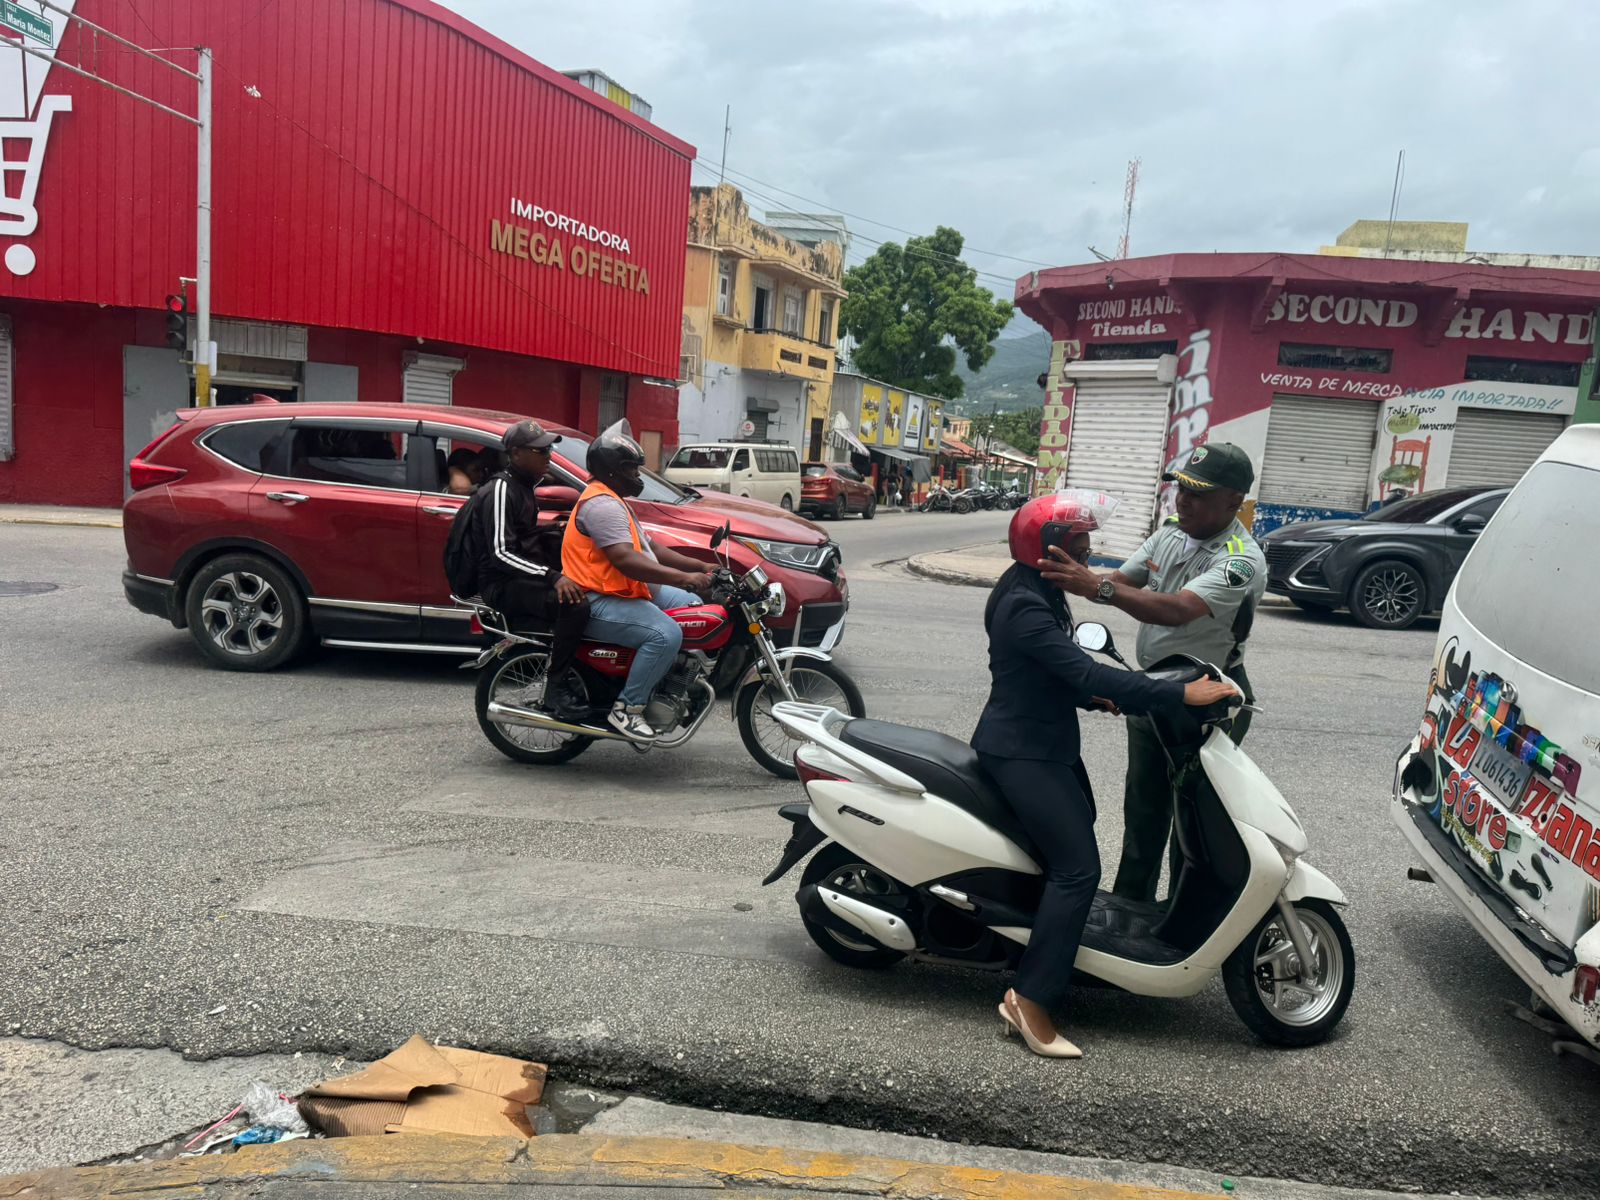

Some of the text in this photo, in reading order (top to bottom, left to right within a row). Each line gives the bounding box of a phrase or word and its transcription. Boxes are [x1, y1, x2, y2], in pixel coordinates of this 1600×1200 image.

[27, 21, 51, 42] Montez
[510, 197, 631, 254] IMPORTADORA
[491, 218, 649, 294] MEGA OFERTA
[1077, 300, 1126, 321] SECOND
[1265, 291, 1594, 345] SECOND HAND
[1091, 319, 1167, 337] Tienda
[1260, 372, 1313, 389] VENTA
[1318, 377, 1340, 391] DE
